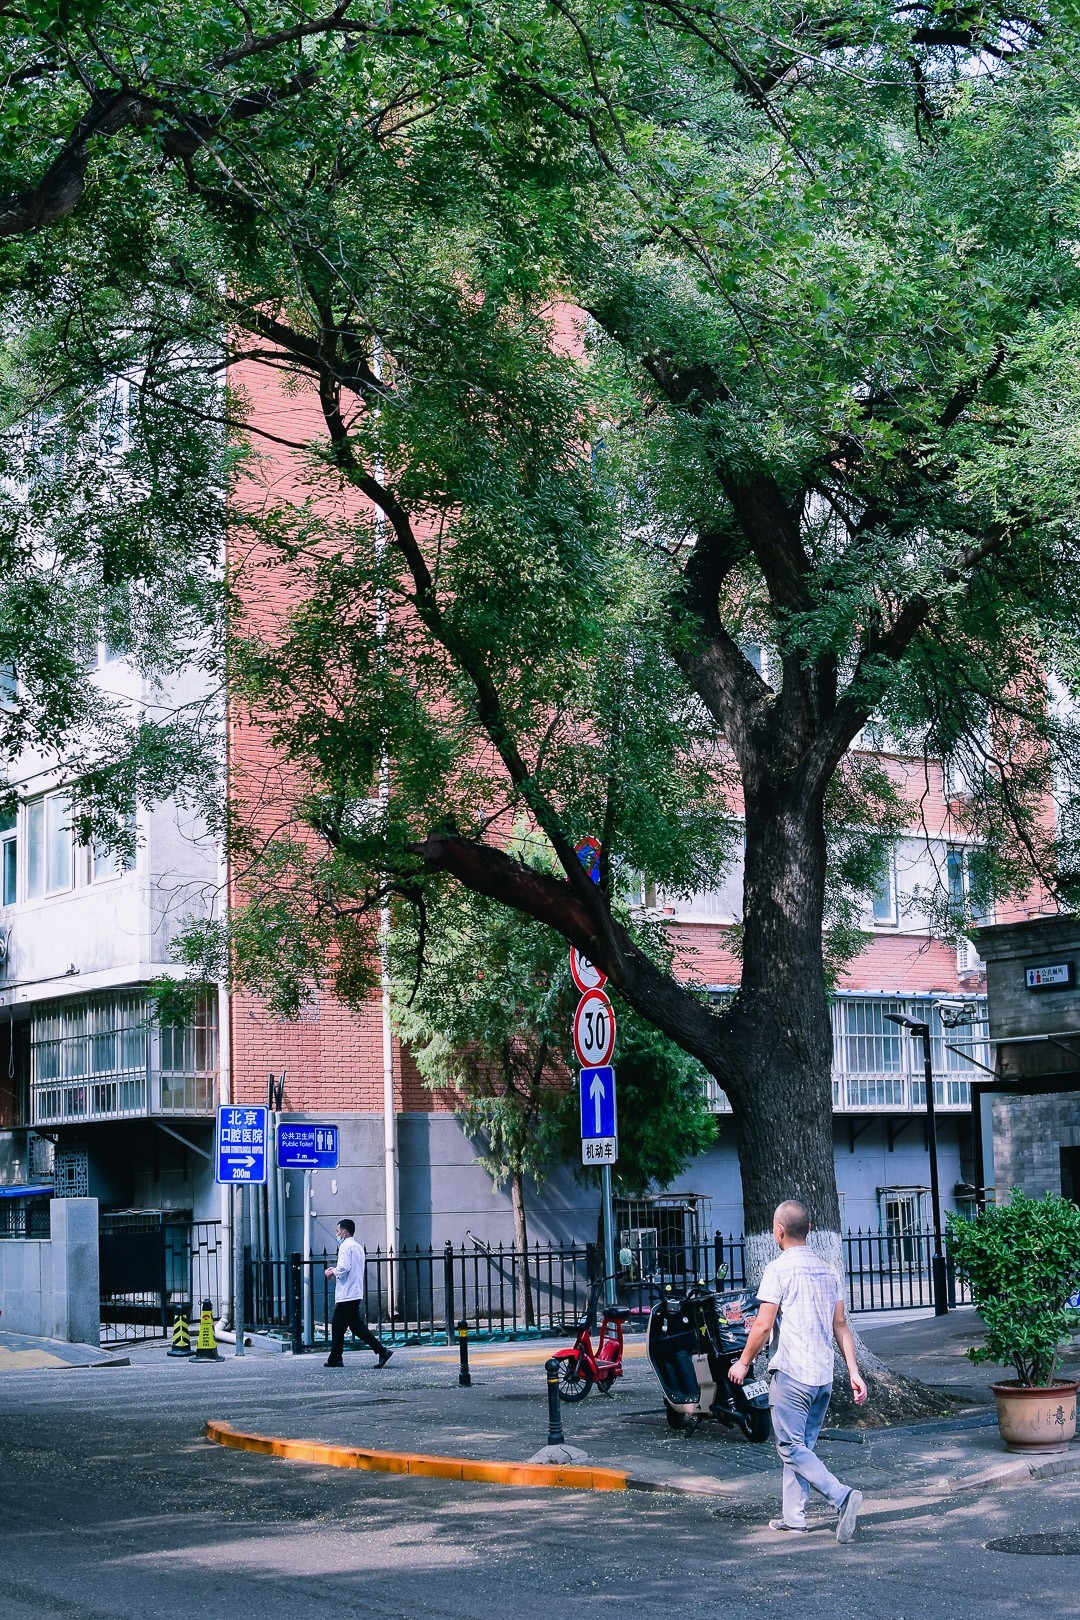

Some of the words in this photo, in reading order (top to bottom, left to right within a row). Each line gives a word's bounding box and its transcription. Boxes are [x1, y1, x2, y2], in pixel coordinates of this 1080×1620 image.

[585, 1012, 605, 1051] 30
[228, 1111, 257, 1125] 北京
[221, 1128, 263, 1143] 口腔医院
[281, 1132, 315, 1140] 公共卫生间
[586, 1143, 612, 1159] 机动车
[232, 1168, 251, 1179] 200m
